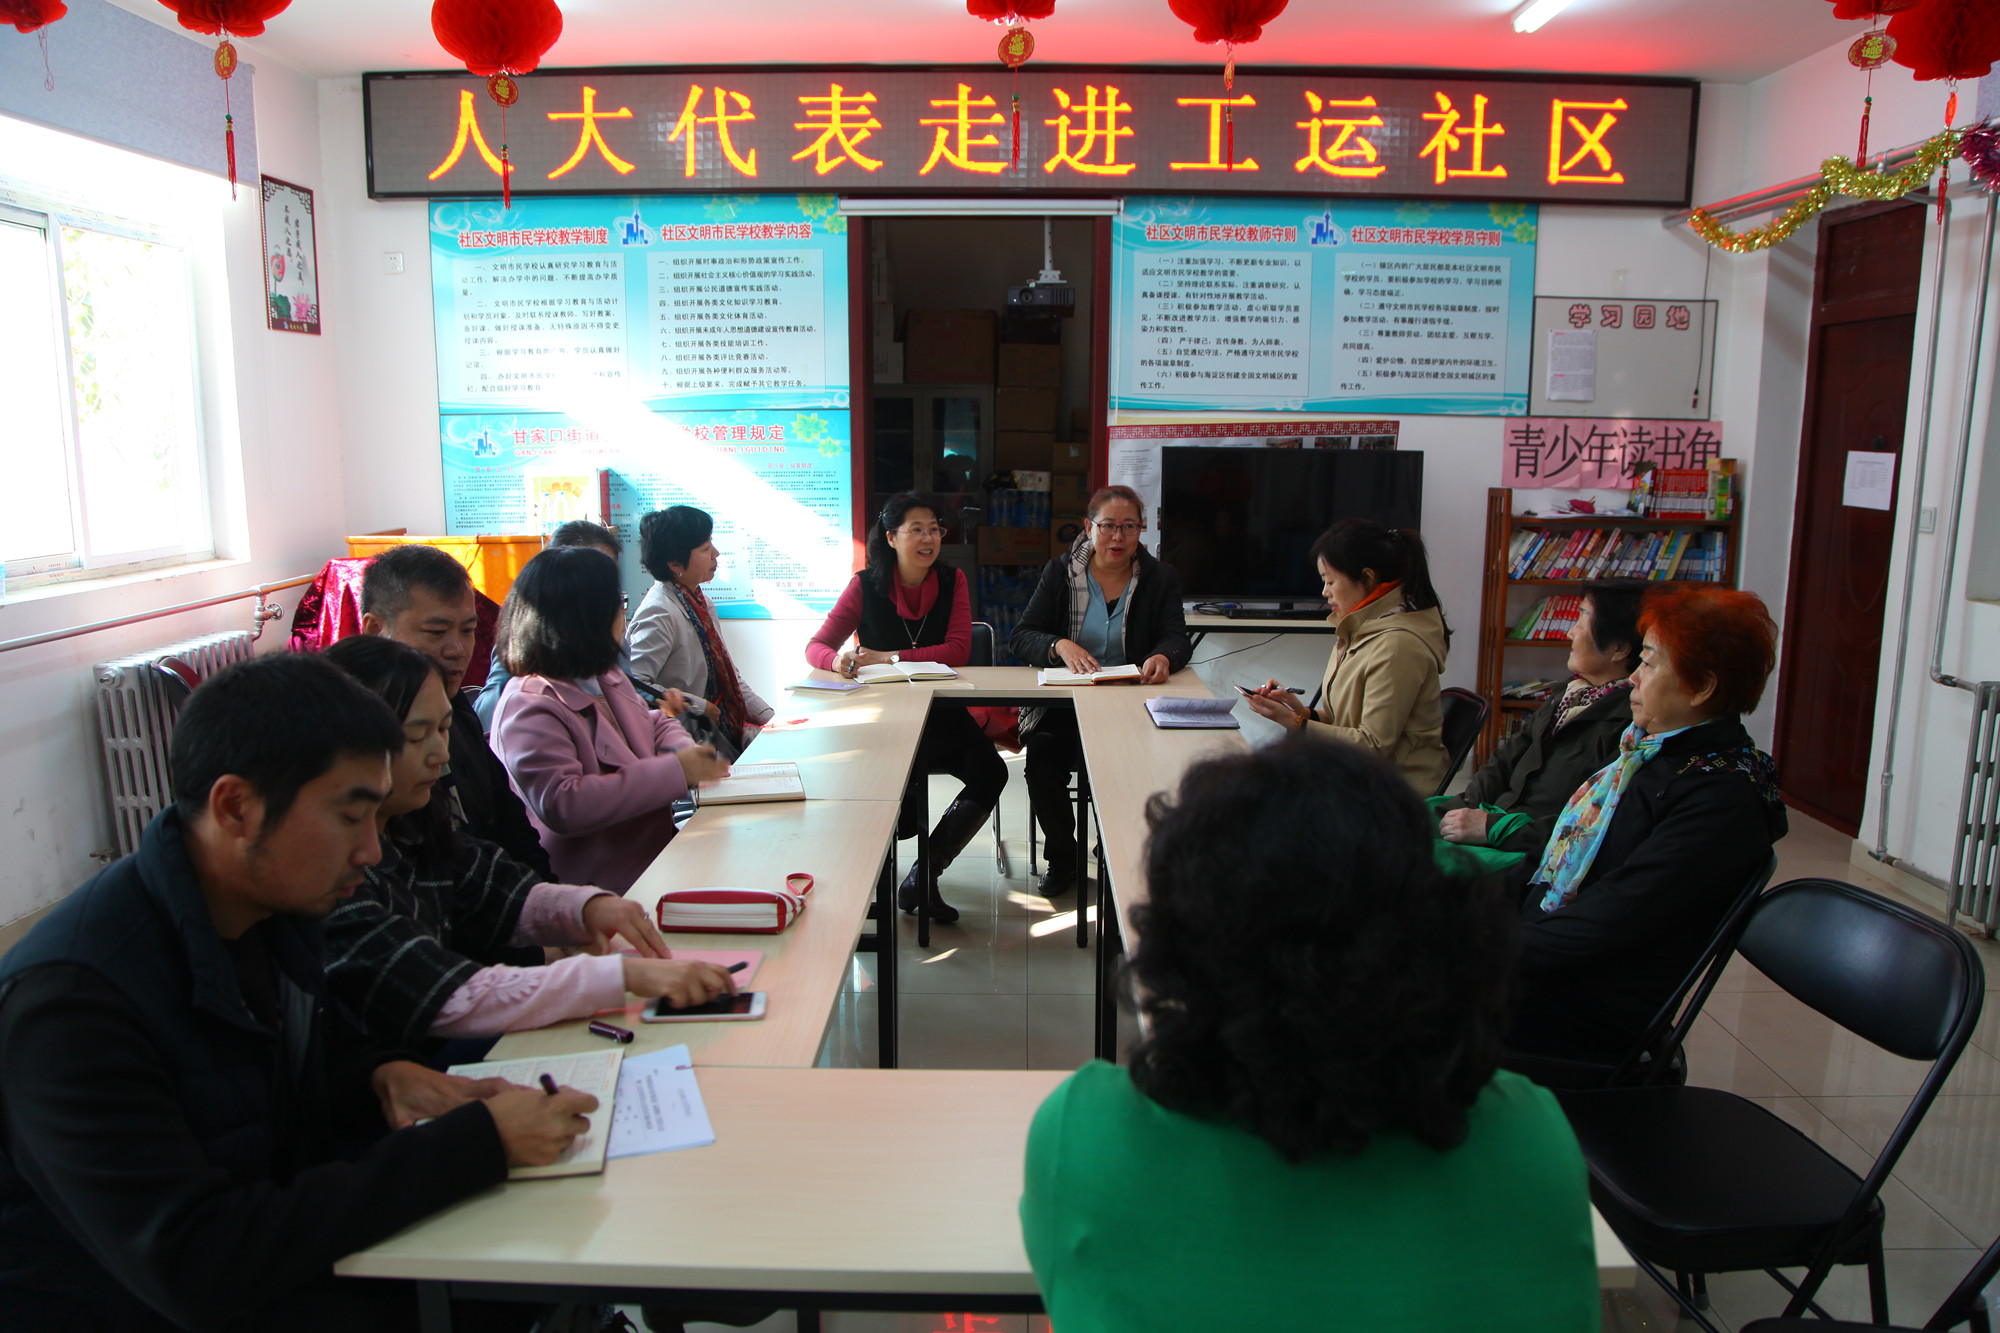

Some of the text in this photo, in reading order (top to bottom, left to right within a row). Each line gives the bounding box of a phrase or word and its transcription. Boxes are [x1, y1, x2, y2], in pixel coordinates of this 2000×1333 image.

[428, 83, 1628, 184] 人大代表走进工运社区
[458, 227, 608, 248] 社区文明市民学校教学制度
[661, 222, 812, 241] 社区文明市民学校教学内容
[1145, 224, 1298, 243] 社区文明市民学校教师守则
[1351, 225, 1502, 247] 社区文明市民学校学员守则
[1568, 303, 1691, 331] 学习园地
[679, 424, 786, 441] 校管理规定
[1508, 422, 1722, 480] 青少年读书角
